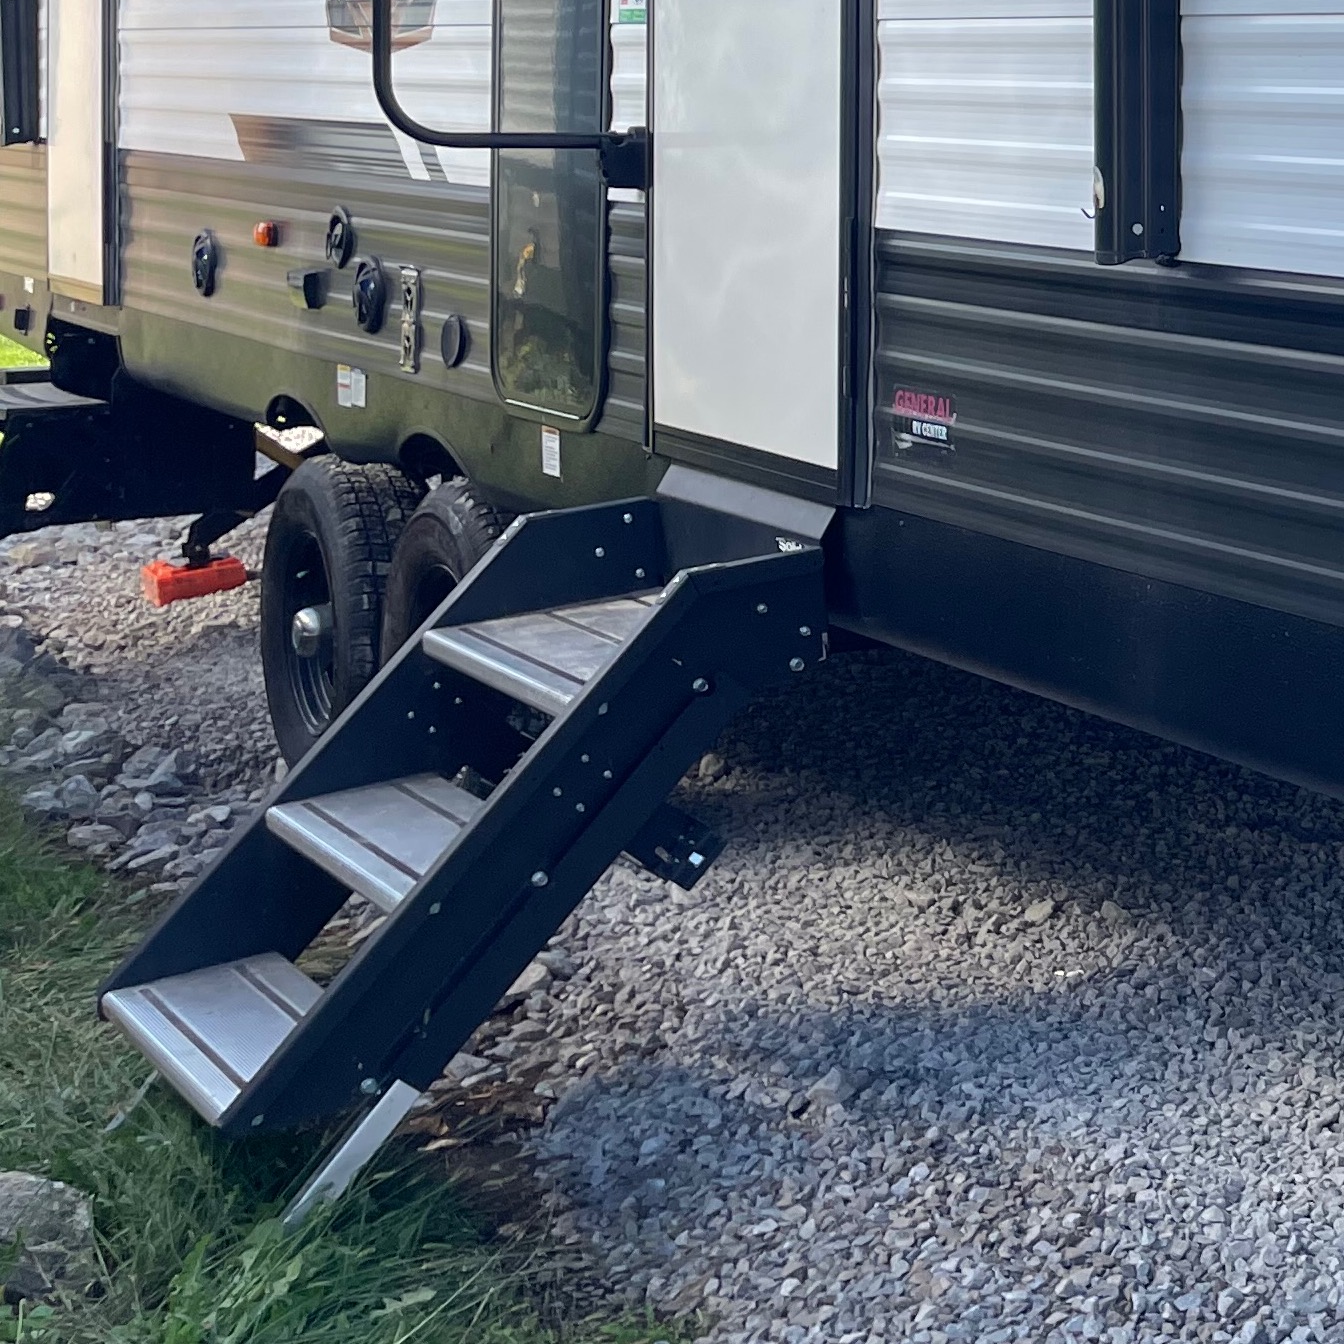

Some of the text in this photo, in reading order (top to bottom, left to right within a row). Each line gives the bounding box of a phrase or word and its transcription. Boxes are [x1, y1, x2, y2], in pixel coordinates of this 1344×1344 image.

[895, 390, 951, 419] GENERAL
[912, 420, 947, 440] RV CENTER
